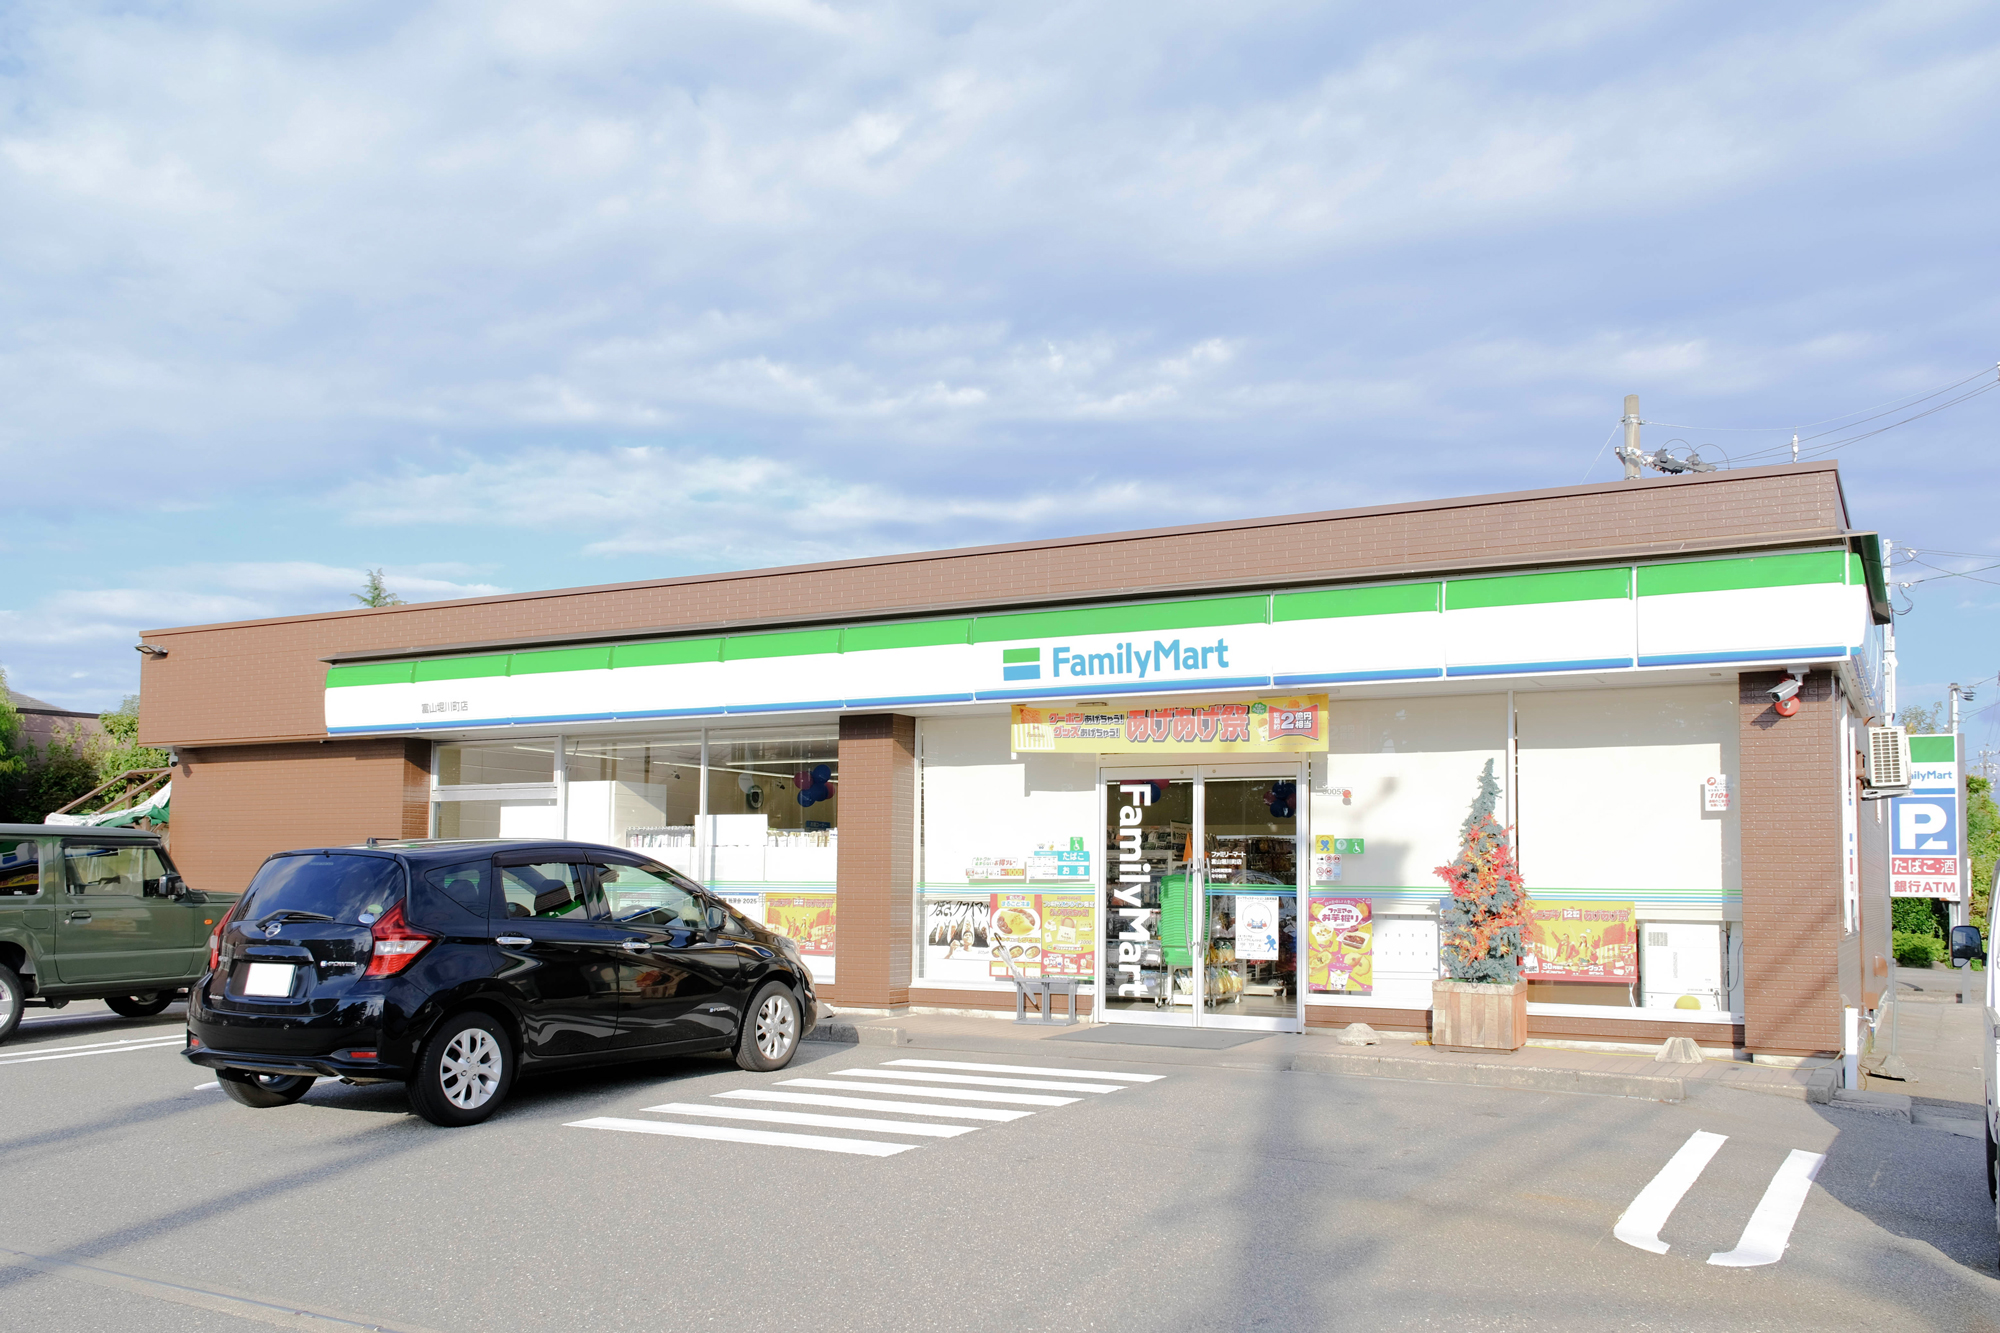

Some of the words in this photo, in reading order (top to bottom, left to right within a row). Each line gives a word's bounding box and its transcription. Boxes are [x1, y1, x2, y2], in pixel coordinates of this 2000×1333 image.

[1053, 638, 1229, 678] FamilyMart
[1125, 703, 1250, 743] あげあげ祭
[1899, 803, 1947, 850] P
[1062, 852, 1085, 861] たばこ
[1893, 859, 1955, 873] たばこ・酒
[1113, 783, 1151, 997] FamilyMart
[1894, 880, 1956, 893] 銀行ATM
[1321, 914, 1359, 923] お芋掘り
